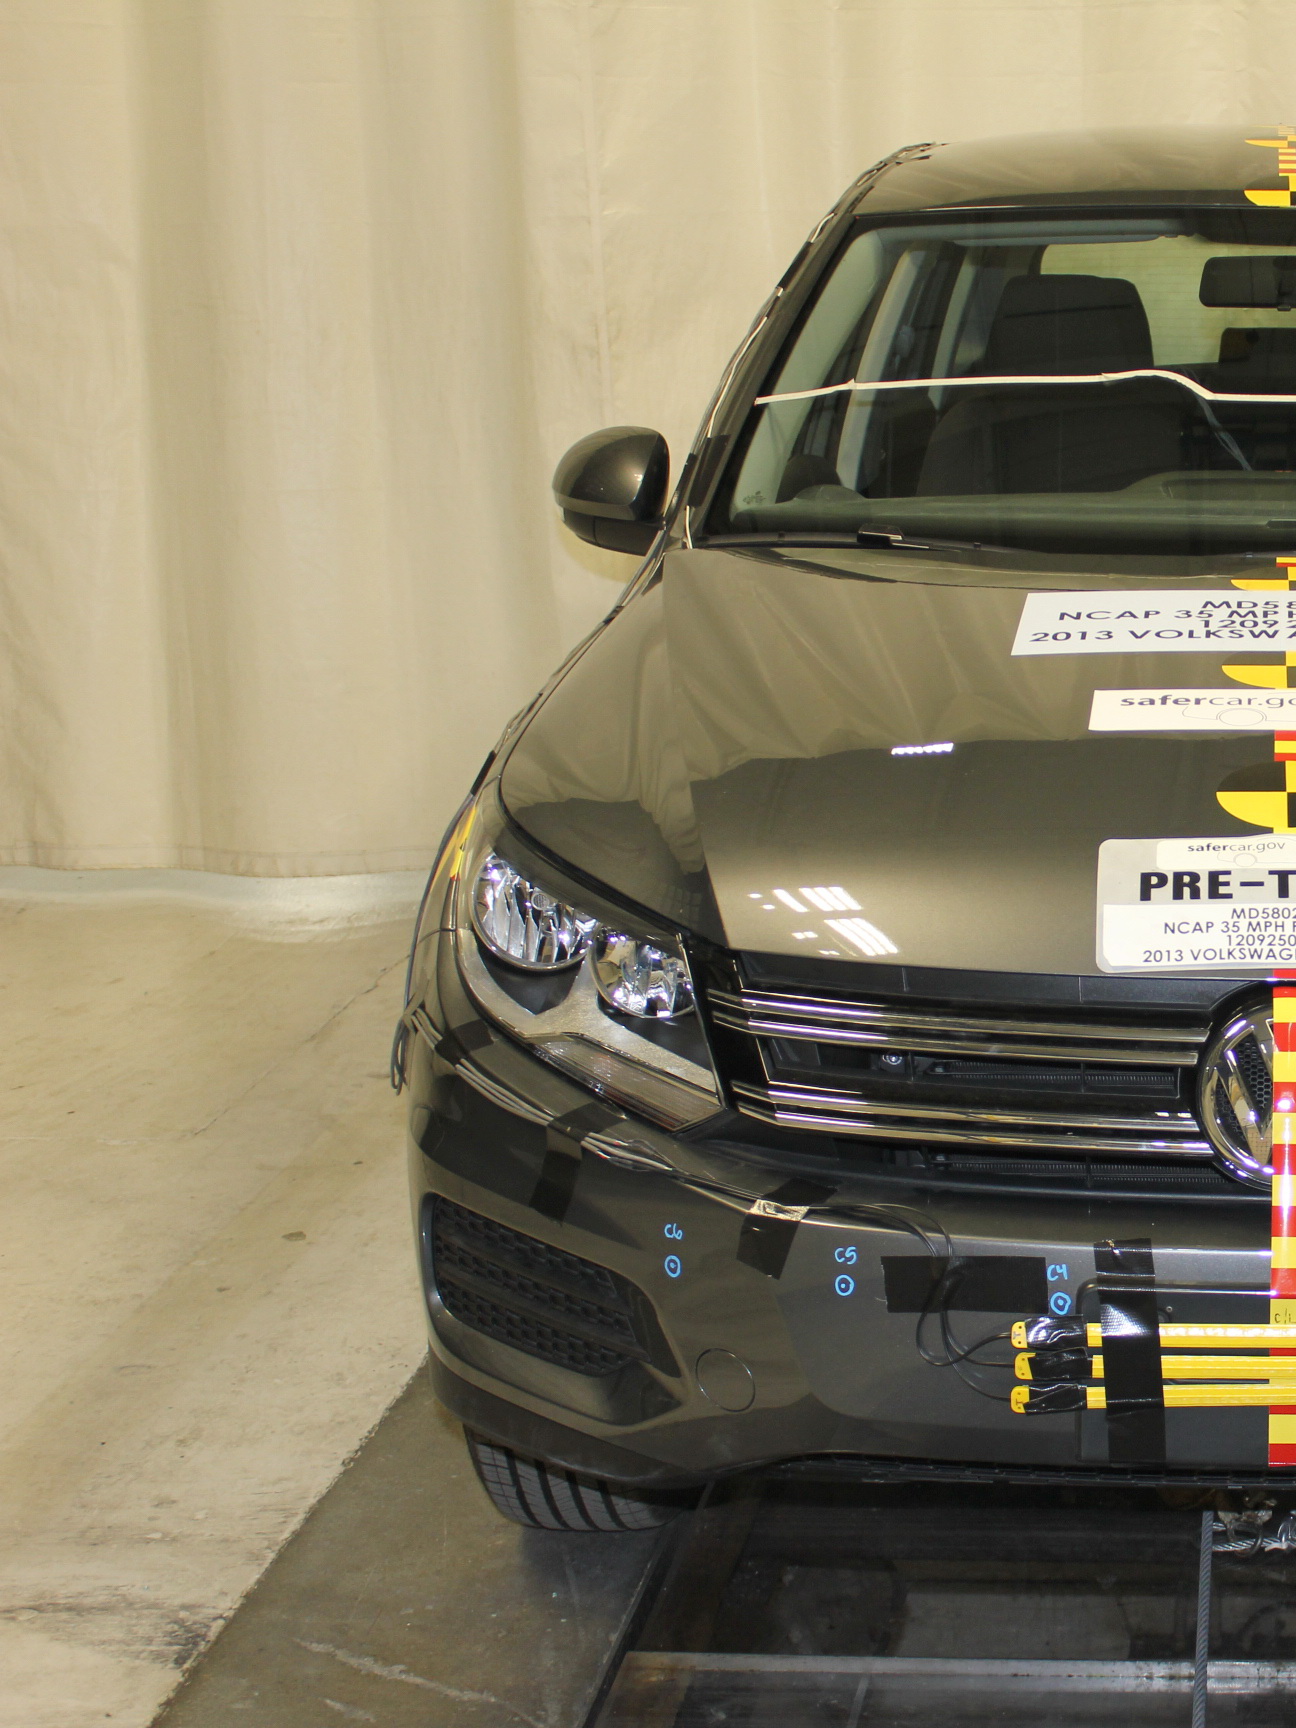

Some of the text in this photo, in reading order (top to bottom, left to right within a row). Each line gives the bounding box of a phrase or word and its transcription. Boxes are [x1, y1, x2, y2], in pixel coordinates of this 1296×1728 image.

[1058, 610, 1161, 621] NCAP
[1174, 609, 1214, 619] 35
[1029, 630, 1114, 643] 2013
[1187, 840, 1286, 853] safercar.gov
[1163, 921, 1214, 934] NCAP
[1221, 921, 1240, 933] 35
[1246, 921, 1285, 933] MPH
[1143, 949, 1184, 963] 2013
[664, 1222, 684, 1240] C6
[834, 1245, 858, 1265] C5
[1046, 1263, 1069, 1281] C4
